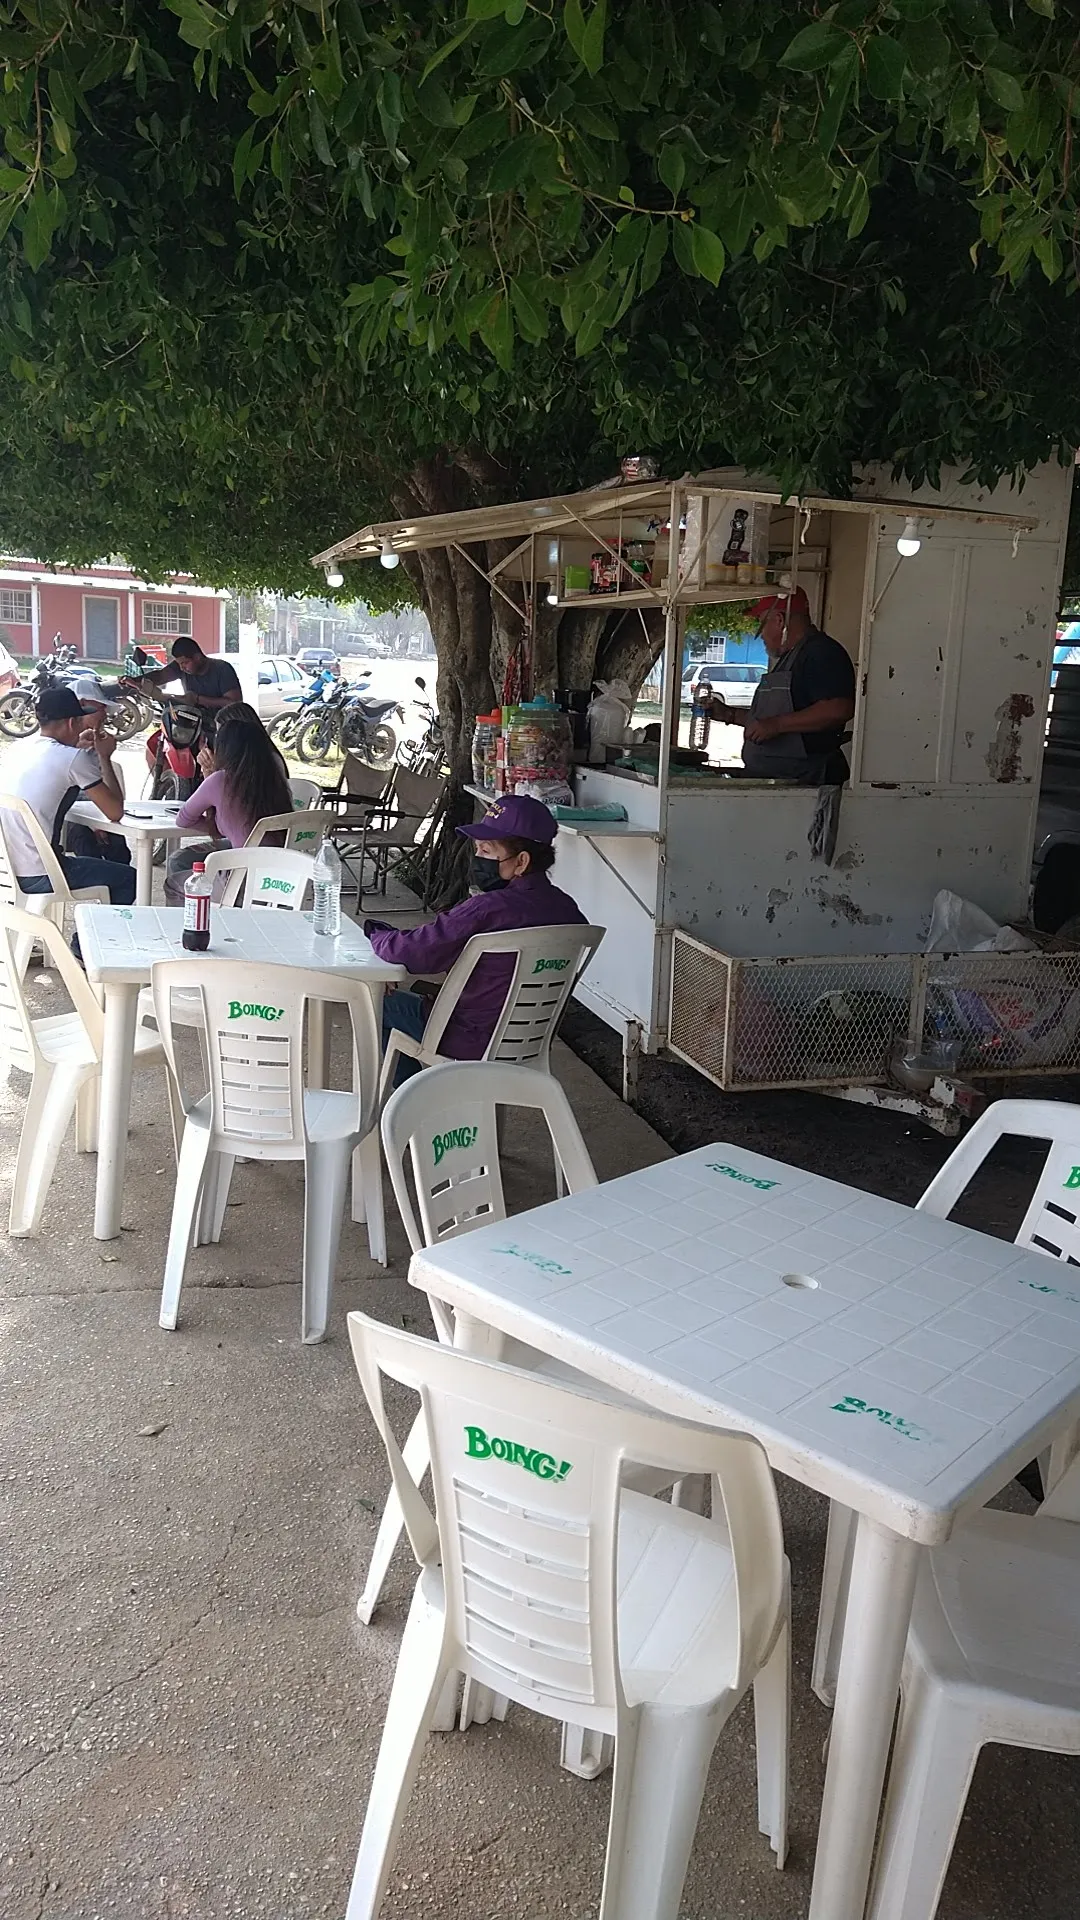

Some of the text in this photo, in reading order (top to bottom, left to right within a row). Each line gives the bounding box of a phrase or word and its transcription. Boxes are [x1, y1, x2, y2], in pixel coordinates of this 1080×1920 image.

[261, 877, 295, 893] BOING!
[531, 958, 571, 974] BOING!
[227, 1001, 285, 1021] BOING!
[432, 1126, 478, 1166] BOING!
[463, 1426, 572, 1480] BOING!
